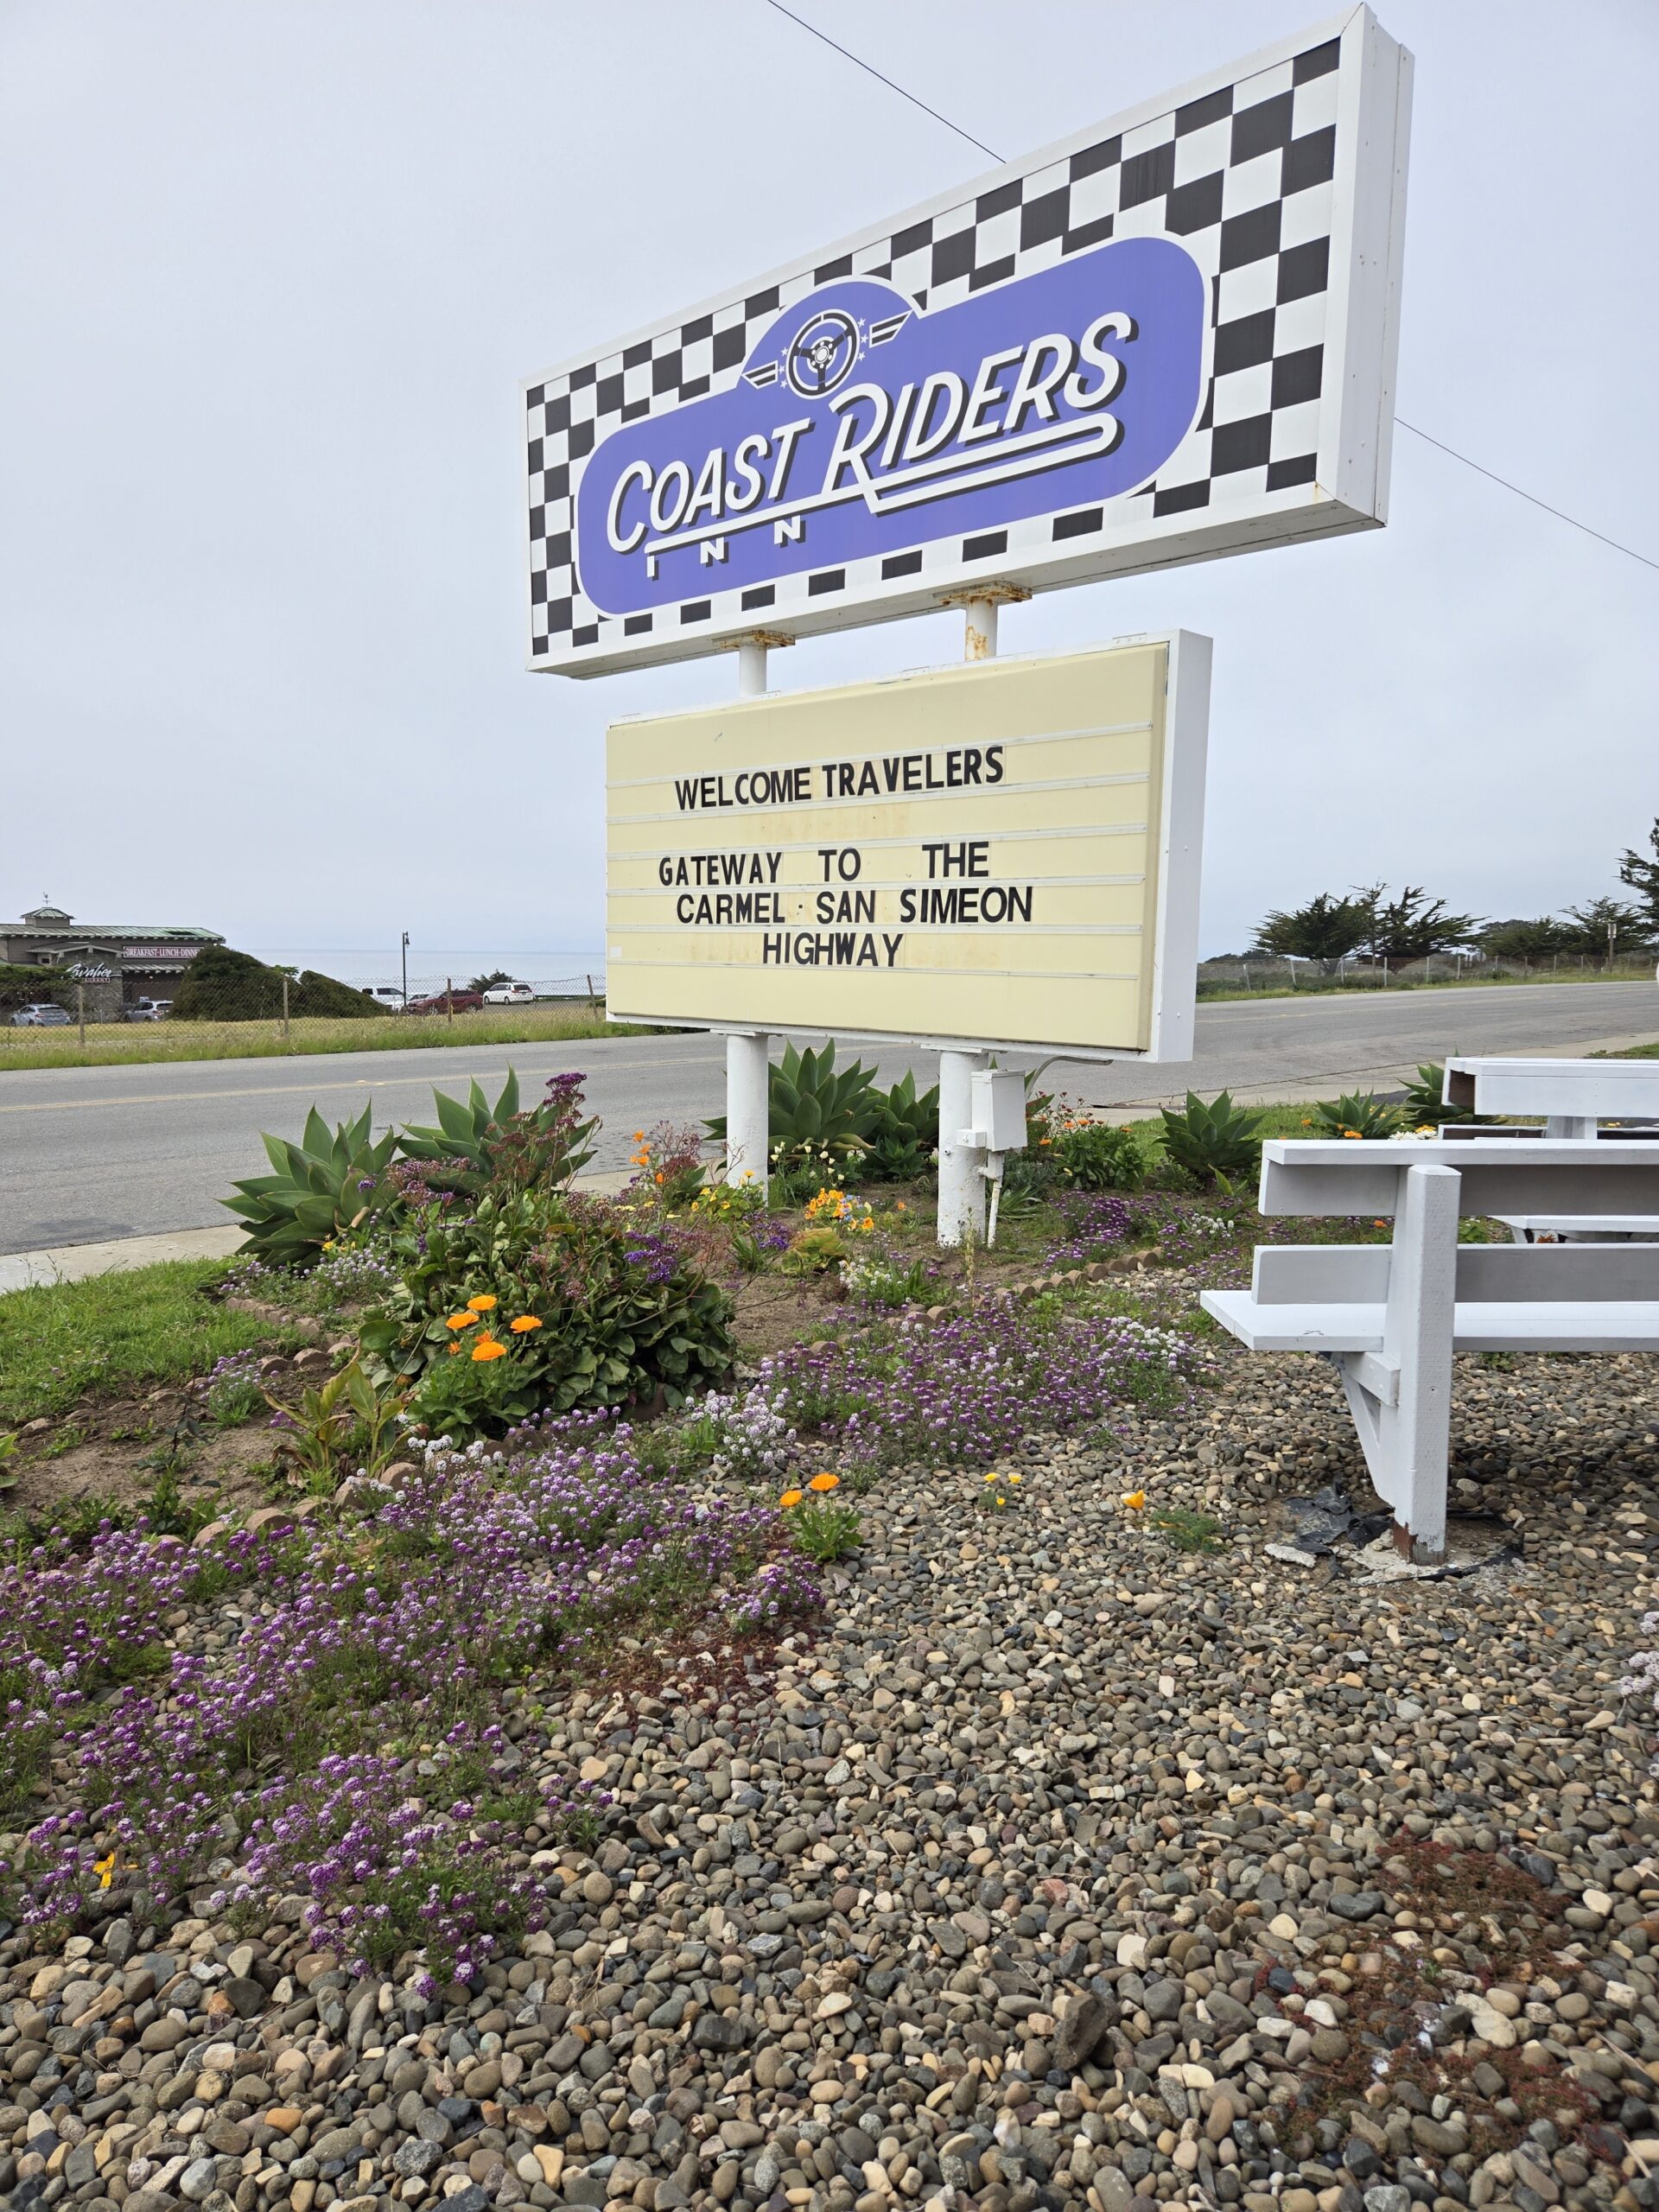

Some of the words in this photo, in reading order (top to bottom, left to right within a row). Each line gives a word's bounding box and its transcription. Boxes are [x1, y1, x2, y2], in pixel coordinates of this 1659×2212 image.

[606, 416, 814, 555] COAST
[819, 311, 1139, 510] RIDERS
[674, 766, 811, 810] WELCOME
[822, 746, 1003, 798] TRAVELERS
[658, 852, 782, 887] GATEWAY
[817, 848, 861, 882] TO
[922, 841, 989, 879] THE
[677, 892, 785, 925] CARMEL
[817, 890, 875, 925] SAN
[900, 886, 1033, 924] SIMEON
[763, 932, 904, 967] HIGHWAY
